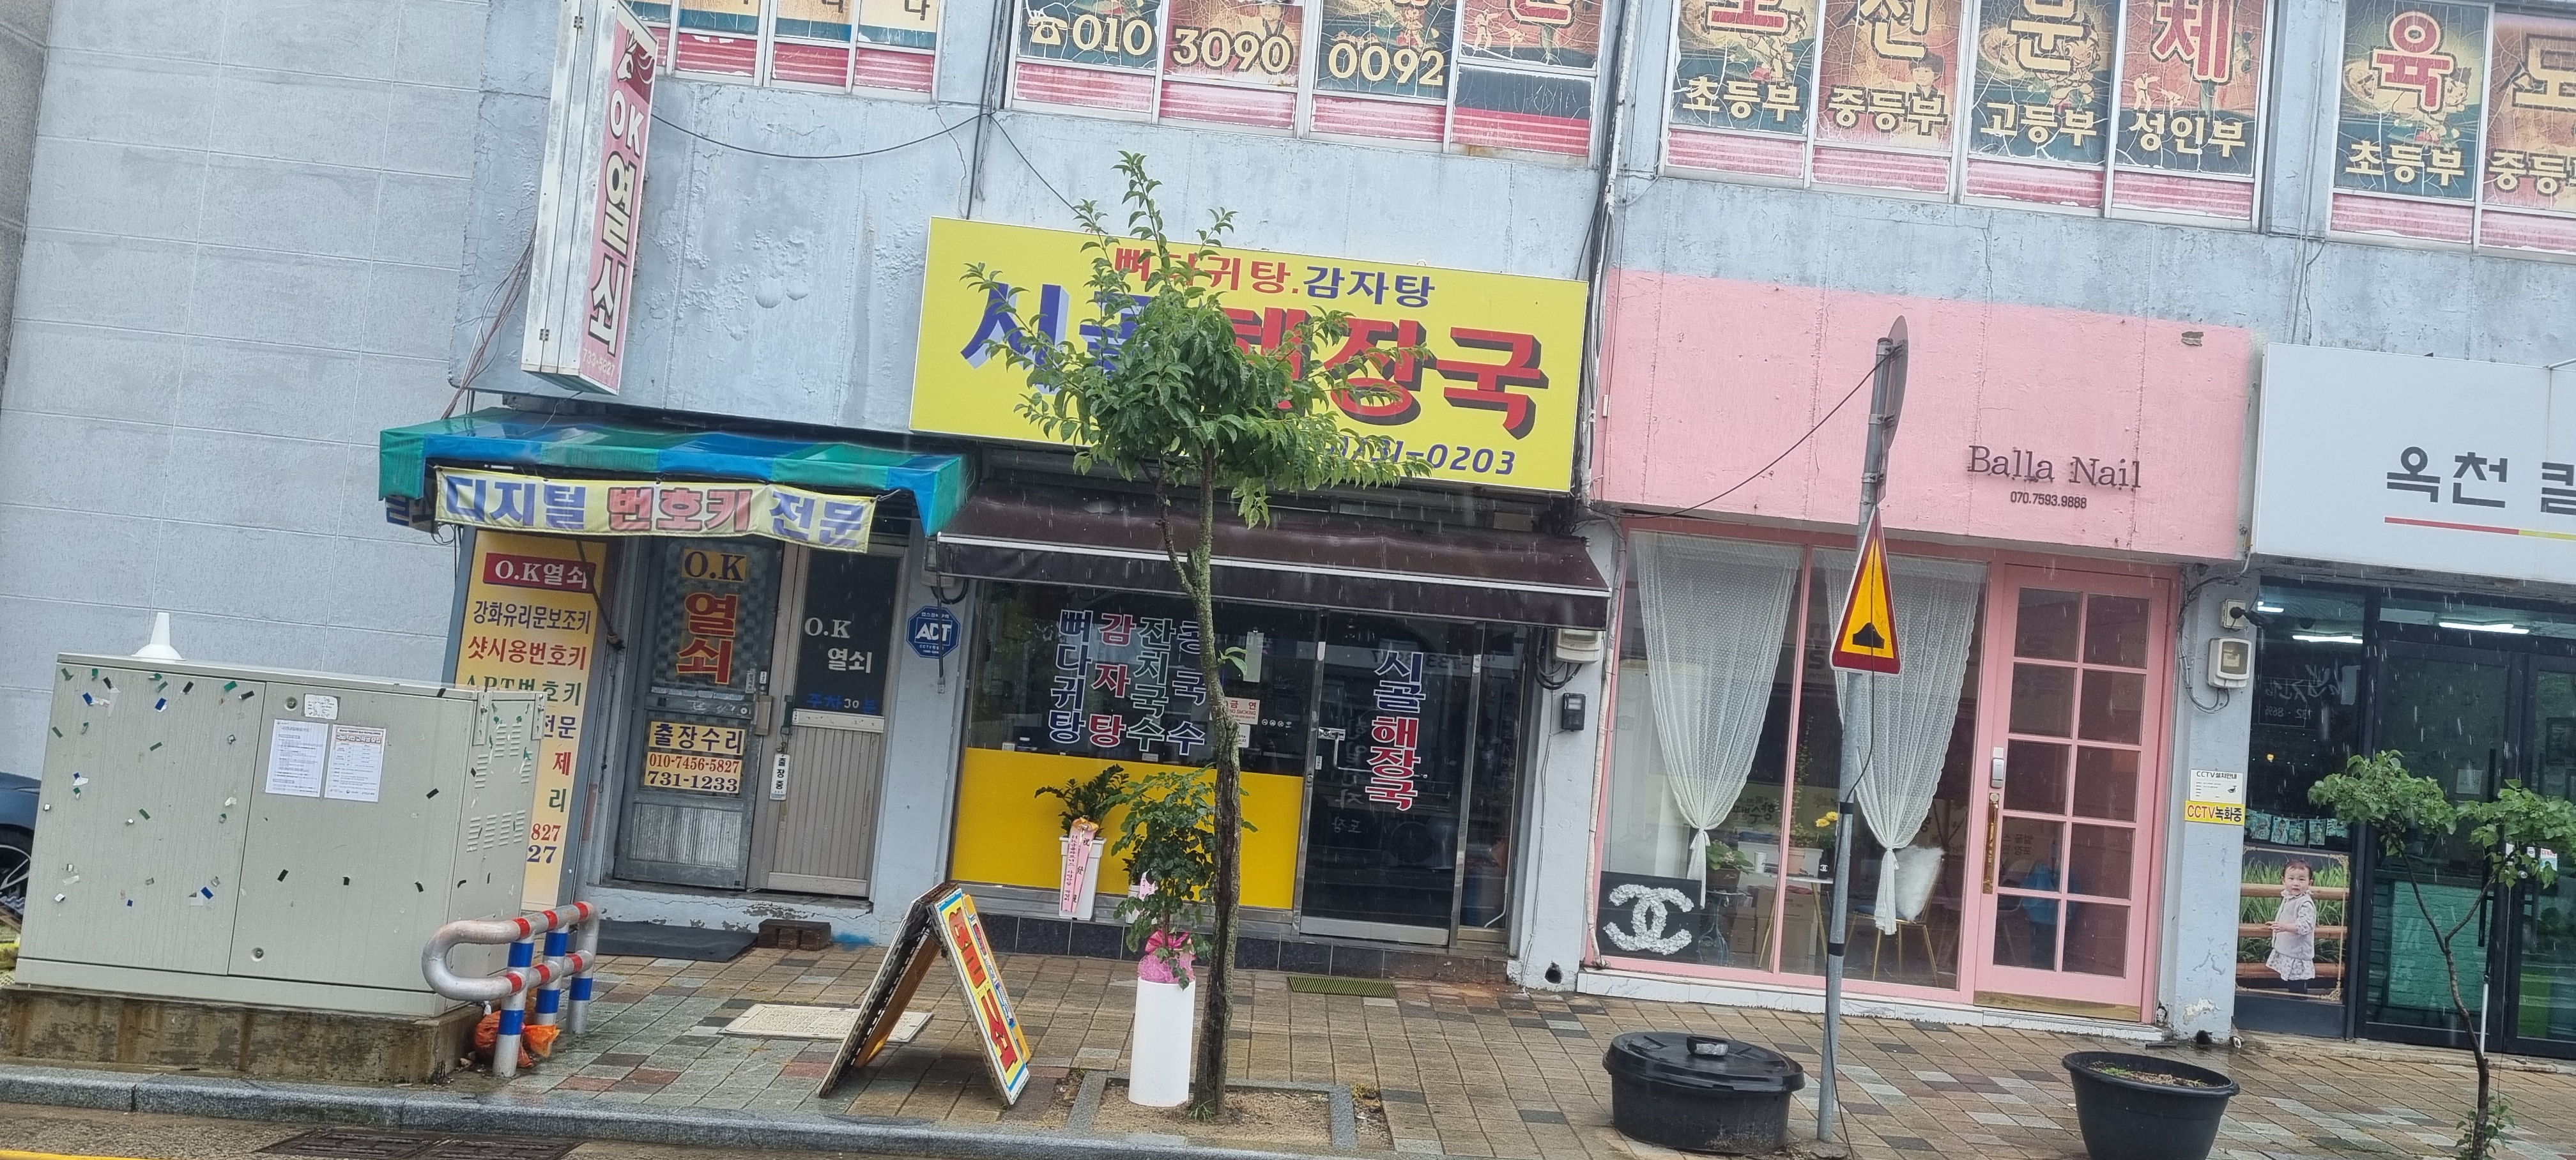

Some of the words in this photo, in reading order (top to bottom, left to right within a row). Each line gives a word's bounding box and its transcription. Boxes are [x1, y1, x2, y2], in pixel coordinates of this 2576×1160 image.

[1073, 14, 1155, 57] 010
[1171, 26, 1292, 75] 3090
[1328, 41, 1445, 88] 0092
[2372, 11, 2453, 113] 육
[610, 89, 645, 157] OK
[1682, 77, 1801, 122] 초등부
[1828, 86, 1946, 131] 중등부
[1981, 102, 2097, 147] 고등부
[2129, 112, 2246, 158] 성인부
[2345, 141, 2464, 187] 초등부
[2488, 150, 2576, 195] 중등
[588, 151, 637, 356] 열쇠
[1967, 445, 2055, 480] Balla
[2069, 456, 2141, 488] Nail
[2386, 446, 2508, 508] 옥천
[446, 476, 586, 530] 디지털
[608, 485, 753, 533] 번호키
[769, 491, 864, 546] 전문
[2011, 491, 2087, 509] 070.7593.9888
[684, 551, 743, 581] O.K
[473, 600, 591, 634] 강화유리문보조키
[804, 618, 852, 639] O.K
[916, 623, 951, 641] ADT
[677, 593, 737, 685] 열쇠
[828, 647, 871, 673] 열쇠
[1048, 609, 1093, 744] 뼈다귀탕
[1089, 613, 1136, 747] 감자탕
[1126, 616, 1176, 752] 잔치국수
[654, 724, 743, 754] 출장수리
[553, 752, 571, 775] 제
[648, 753, 740, 774] 010-7456-5827
[775, 758, 786, 790] 출장중
[648, 771, 738, 793] 731-1233
[549, 789, 566, 813] 리
[2188, 805, 2242, 822] CCTV녹화중
